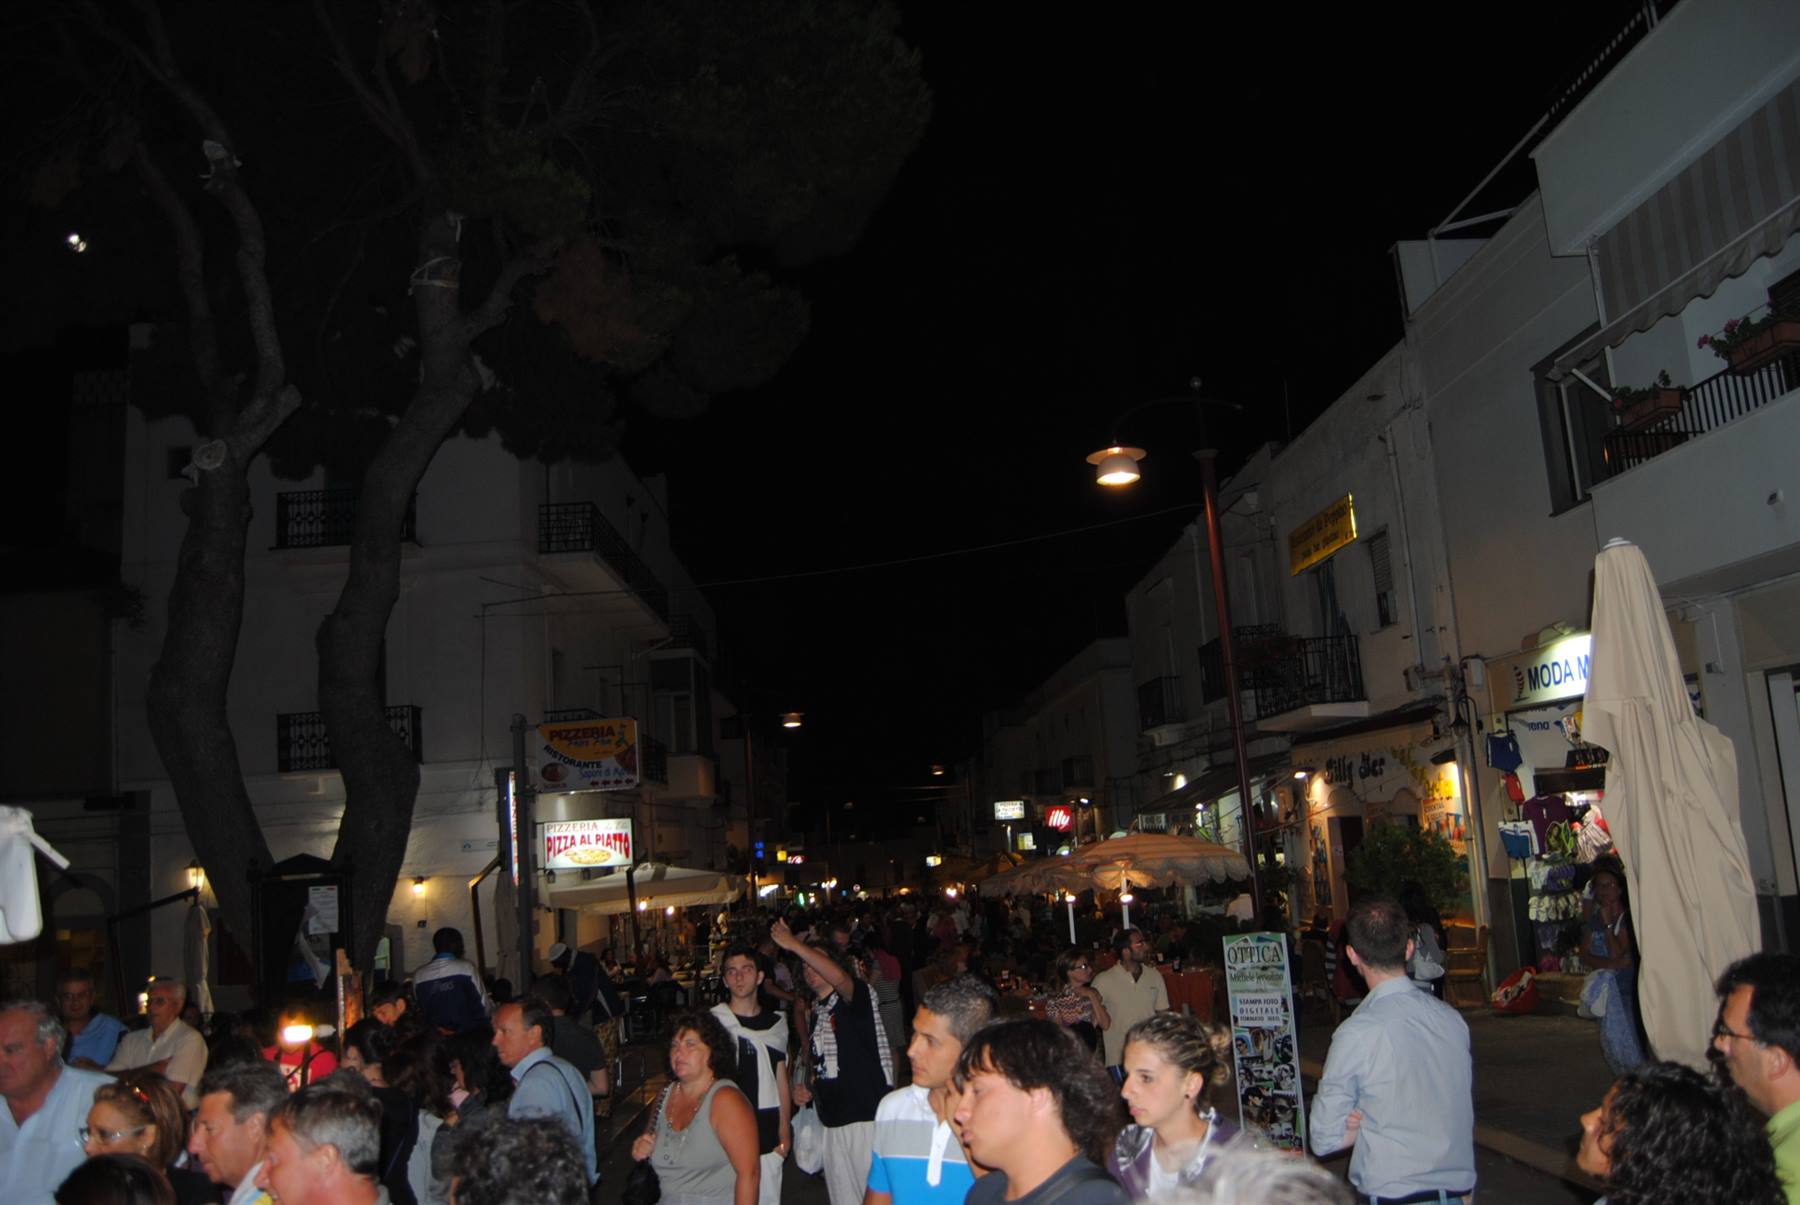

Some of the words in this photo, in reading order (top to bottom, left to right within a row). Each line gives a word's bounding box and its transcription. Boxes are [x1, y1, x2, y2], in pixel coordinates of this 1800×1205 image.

[1527, 658, 1575, 692] MODA
[1577, 653, 1590, 681] M
[549, 726, 616, 741] PIZZERIA
[543, 744, 602, 769] RISTORANTE
[546, 821, 599, 833] PIZZERIA
[1048, 809, 1070, 830] illy
[546, 834, 577, 863] PIZZA
[580, 834, 592, 845] AL
[595, 832, 630, 859] PIATTO
[1227, 945, 1281, 965] OTTICA
[1230, 969, 1255, 982] Michele
